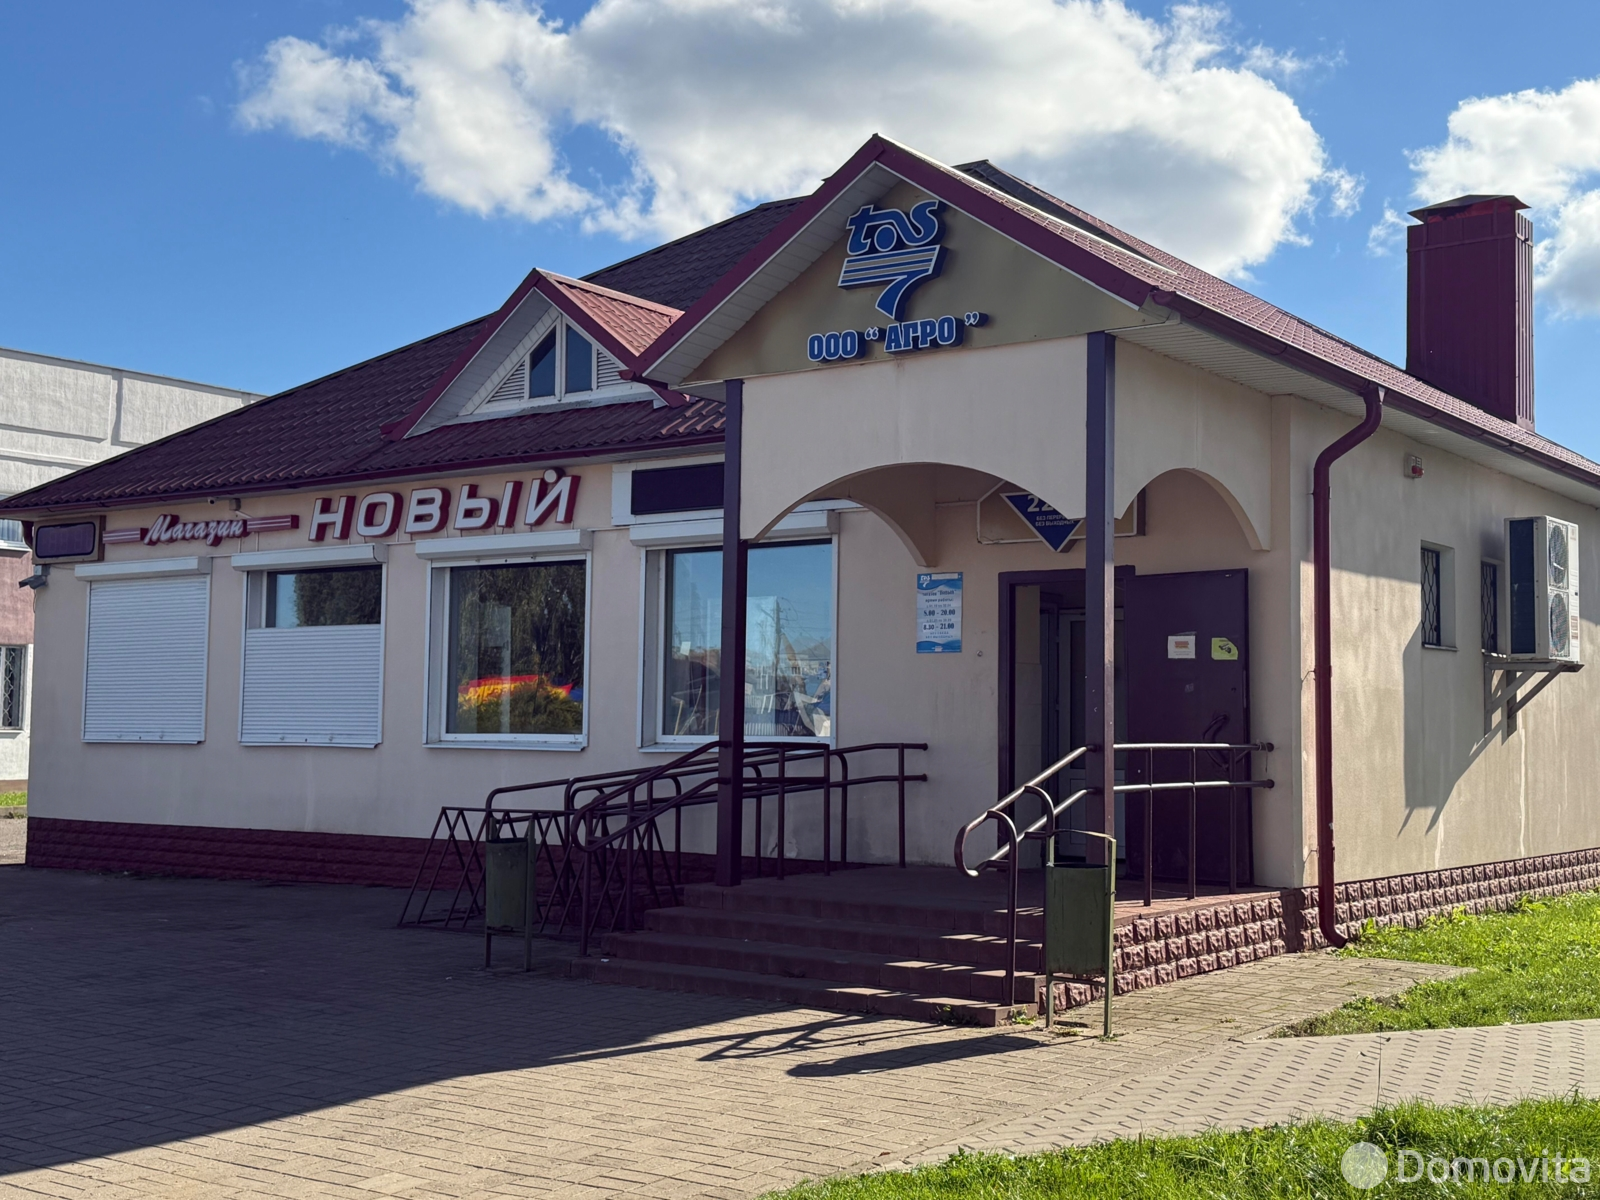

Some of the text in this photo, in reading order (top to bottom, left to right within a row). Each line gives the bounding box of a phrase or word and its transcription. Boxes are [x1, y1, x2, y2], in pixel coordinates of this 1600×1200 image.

[808, 329, 858, 362] ООО
[308, 467, 579, 542] НОВЫЙ
[143, 514, 246, 547] Магазин
